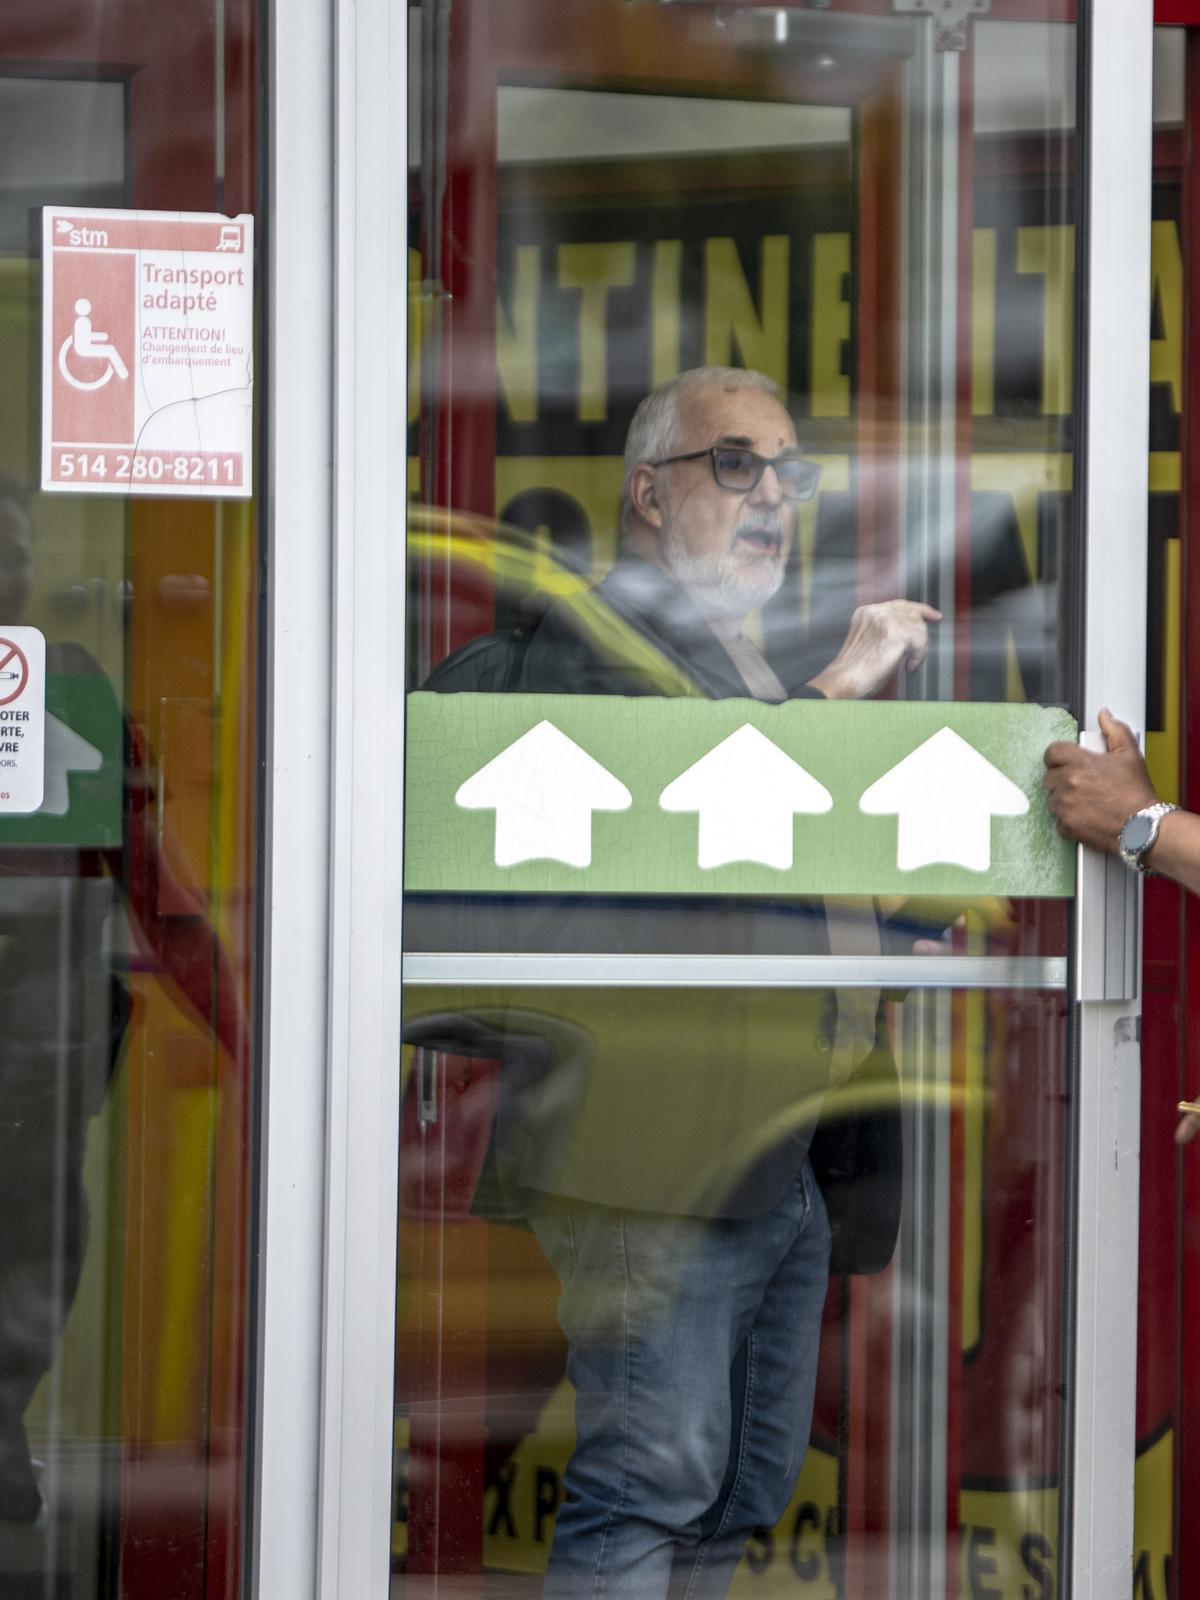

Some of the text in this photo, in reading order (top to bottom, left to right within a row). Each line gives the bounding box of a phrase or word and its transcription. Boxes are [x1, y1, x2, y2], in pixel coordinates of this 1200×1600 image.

[69, 227, 109, 246] stm
[143, 263, 245, 290] Transport
[143, 289, 218, 315] adapté
[143, 326, 226, 341] ATTENTION!
[142, 341, 244, 355] Changement de lieu
[142, 354, 231, 368] d'embarquement
[60, 453, 234, 480] 514 280-8211
[0, 710, 30, 721] OTER
[0, 759, 18, 768] ORS,
